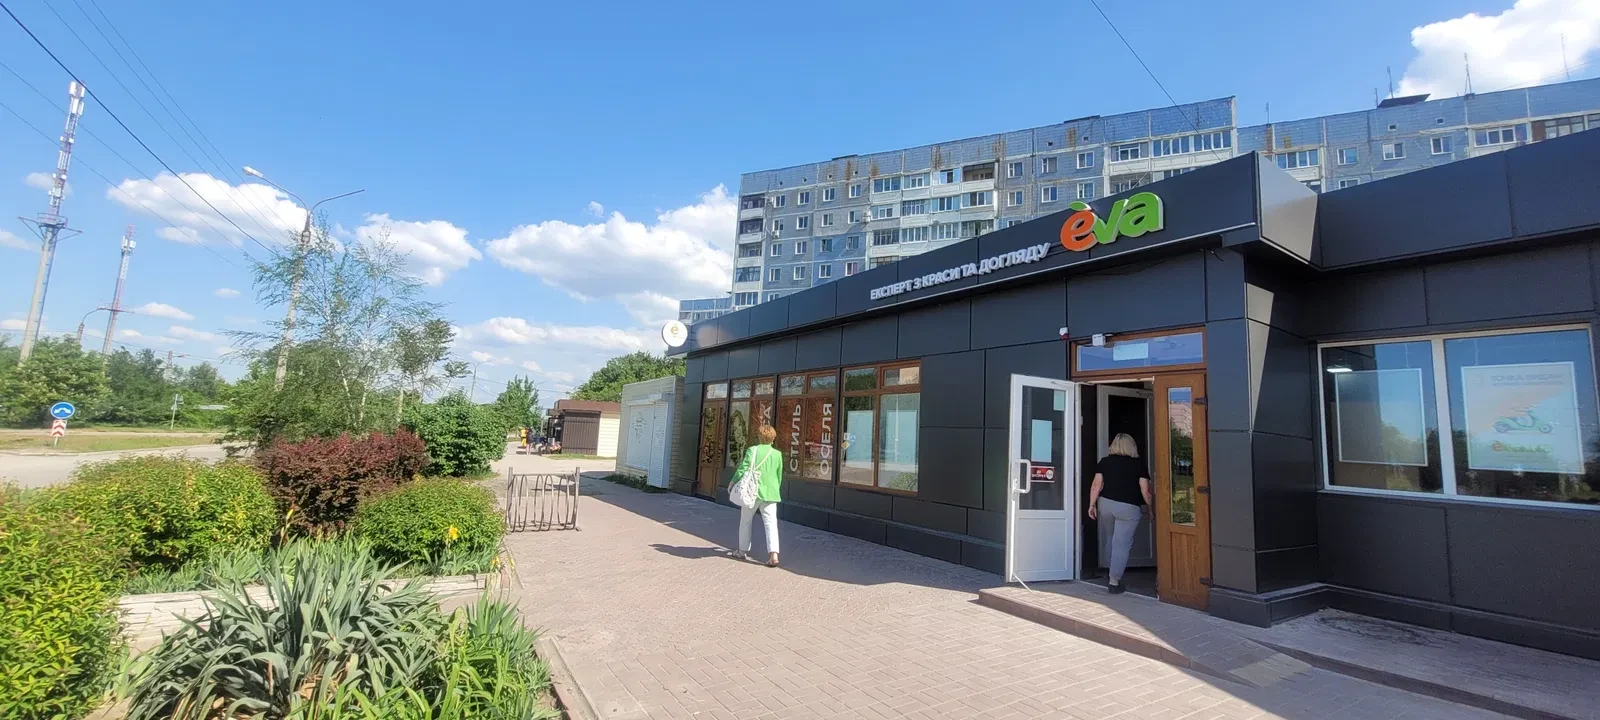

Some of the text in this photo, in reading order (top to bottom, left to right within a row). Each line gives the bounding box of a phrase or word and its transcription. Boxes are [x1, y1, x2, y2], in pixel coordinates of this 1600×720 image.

[870, 279, 913, 300] ЕКСПЕРТ
[922, 266, 961, 288] КРАСИ
[960, 262, 979, 278] ТА
[979, 242, 1052, 276] ДОГЛЯДУ
[789, 404, 802, 472] СТИЛЬ
[820, 403, 835, 475] ОСЕЛЯ
